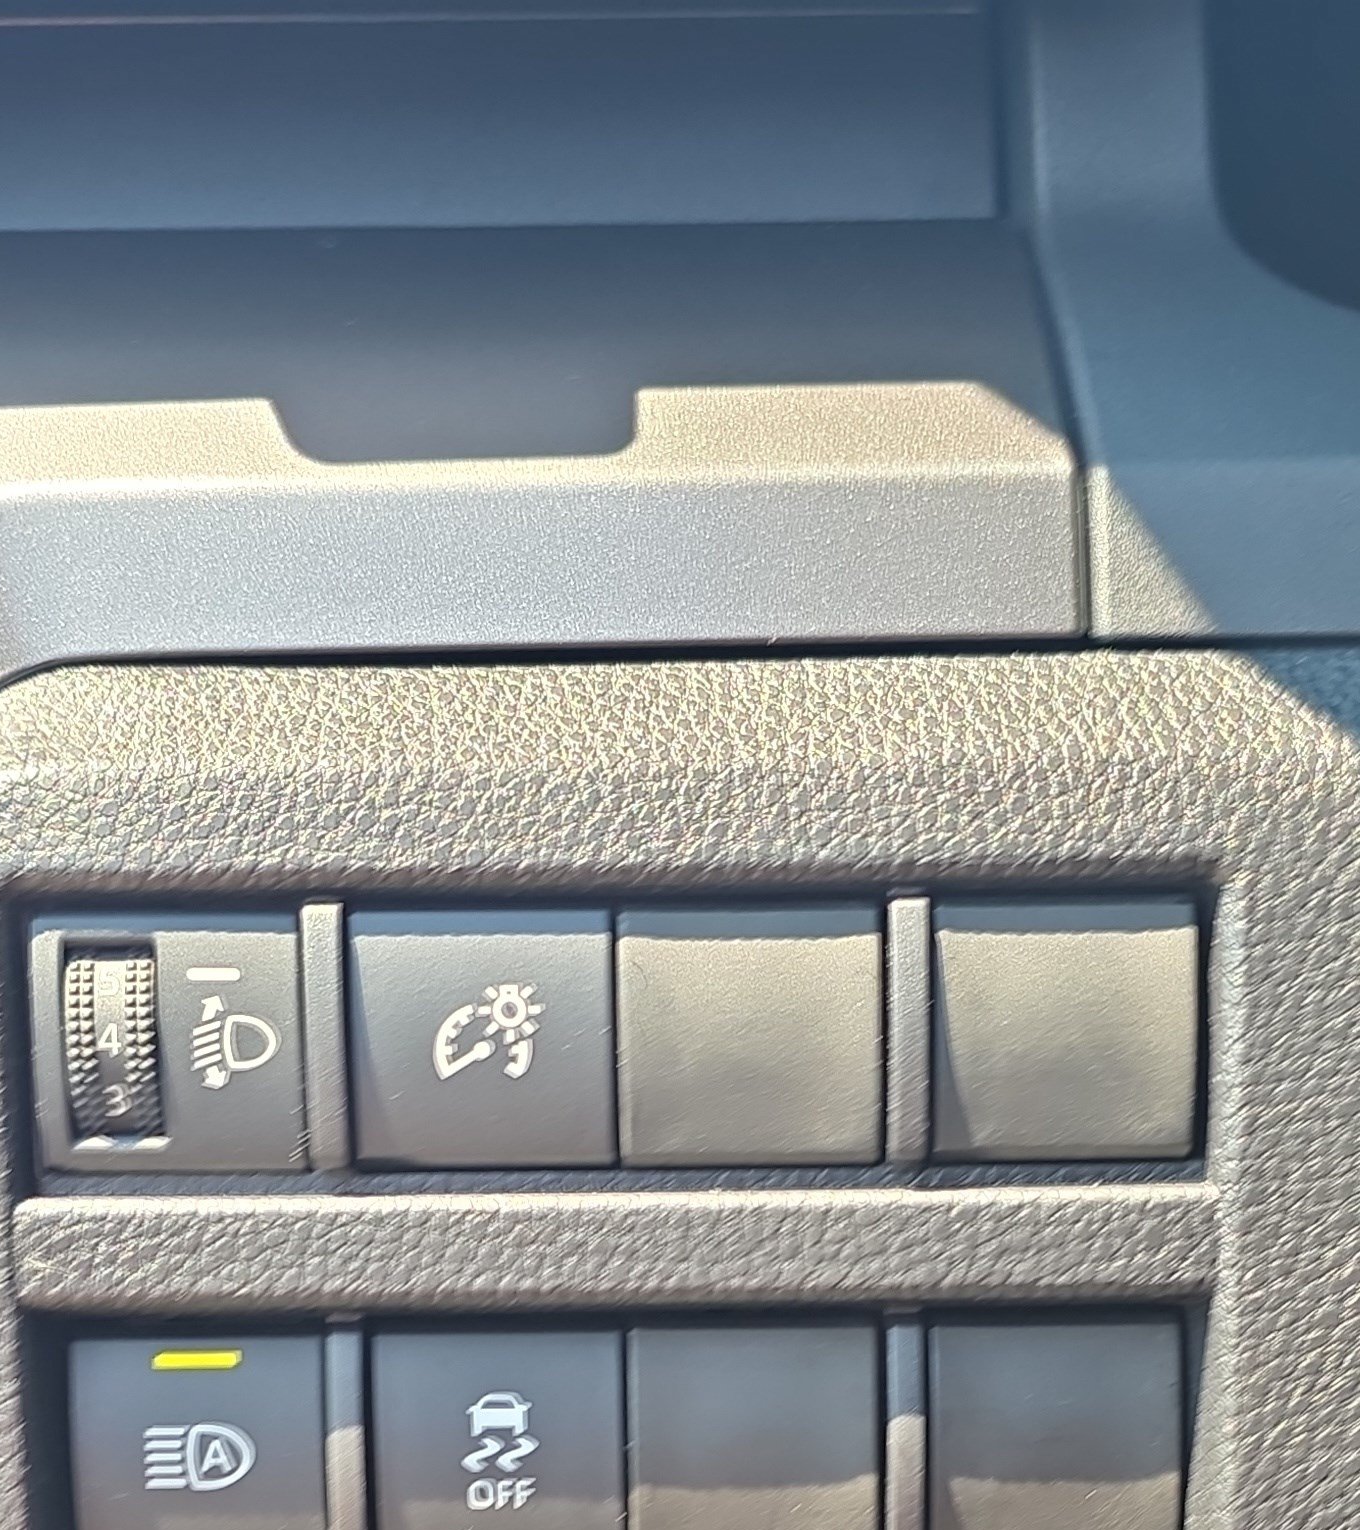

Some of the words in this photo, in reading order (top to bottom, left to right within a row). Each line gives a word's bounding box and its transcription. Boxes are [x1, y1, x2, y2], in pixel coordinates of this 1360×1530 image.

[97, 1023, 122, 1058] 4
[102, 1083, 132, 1117] 3
[200, 1438, 233, 1475] A
[467, 1479, 536, 1510] OFF
